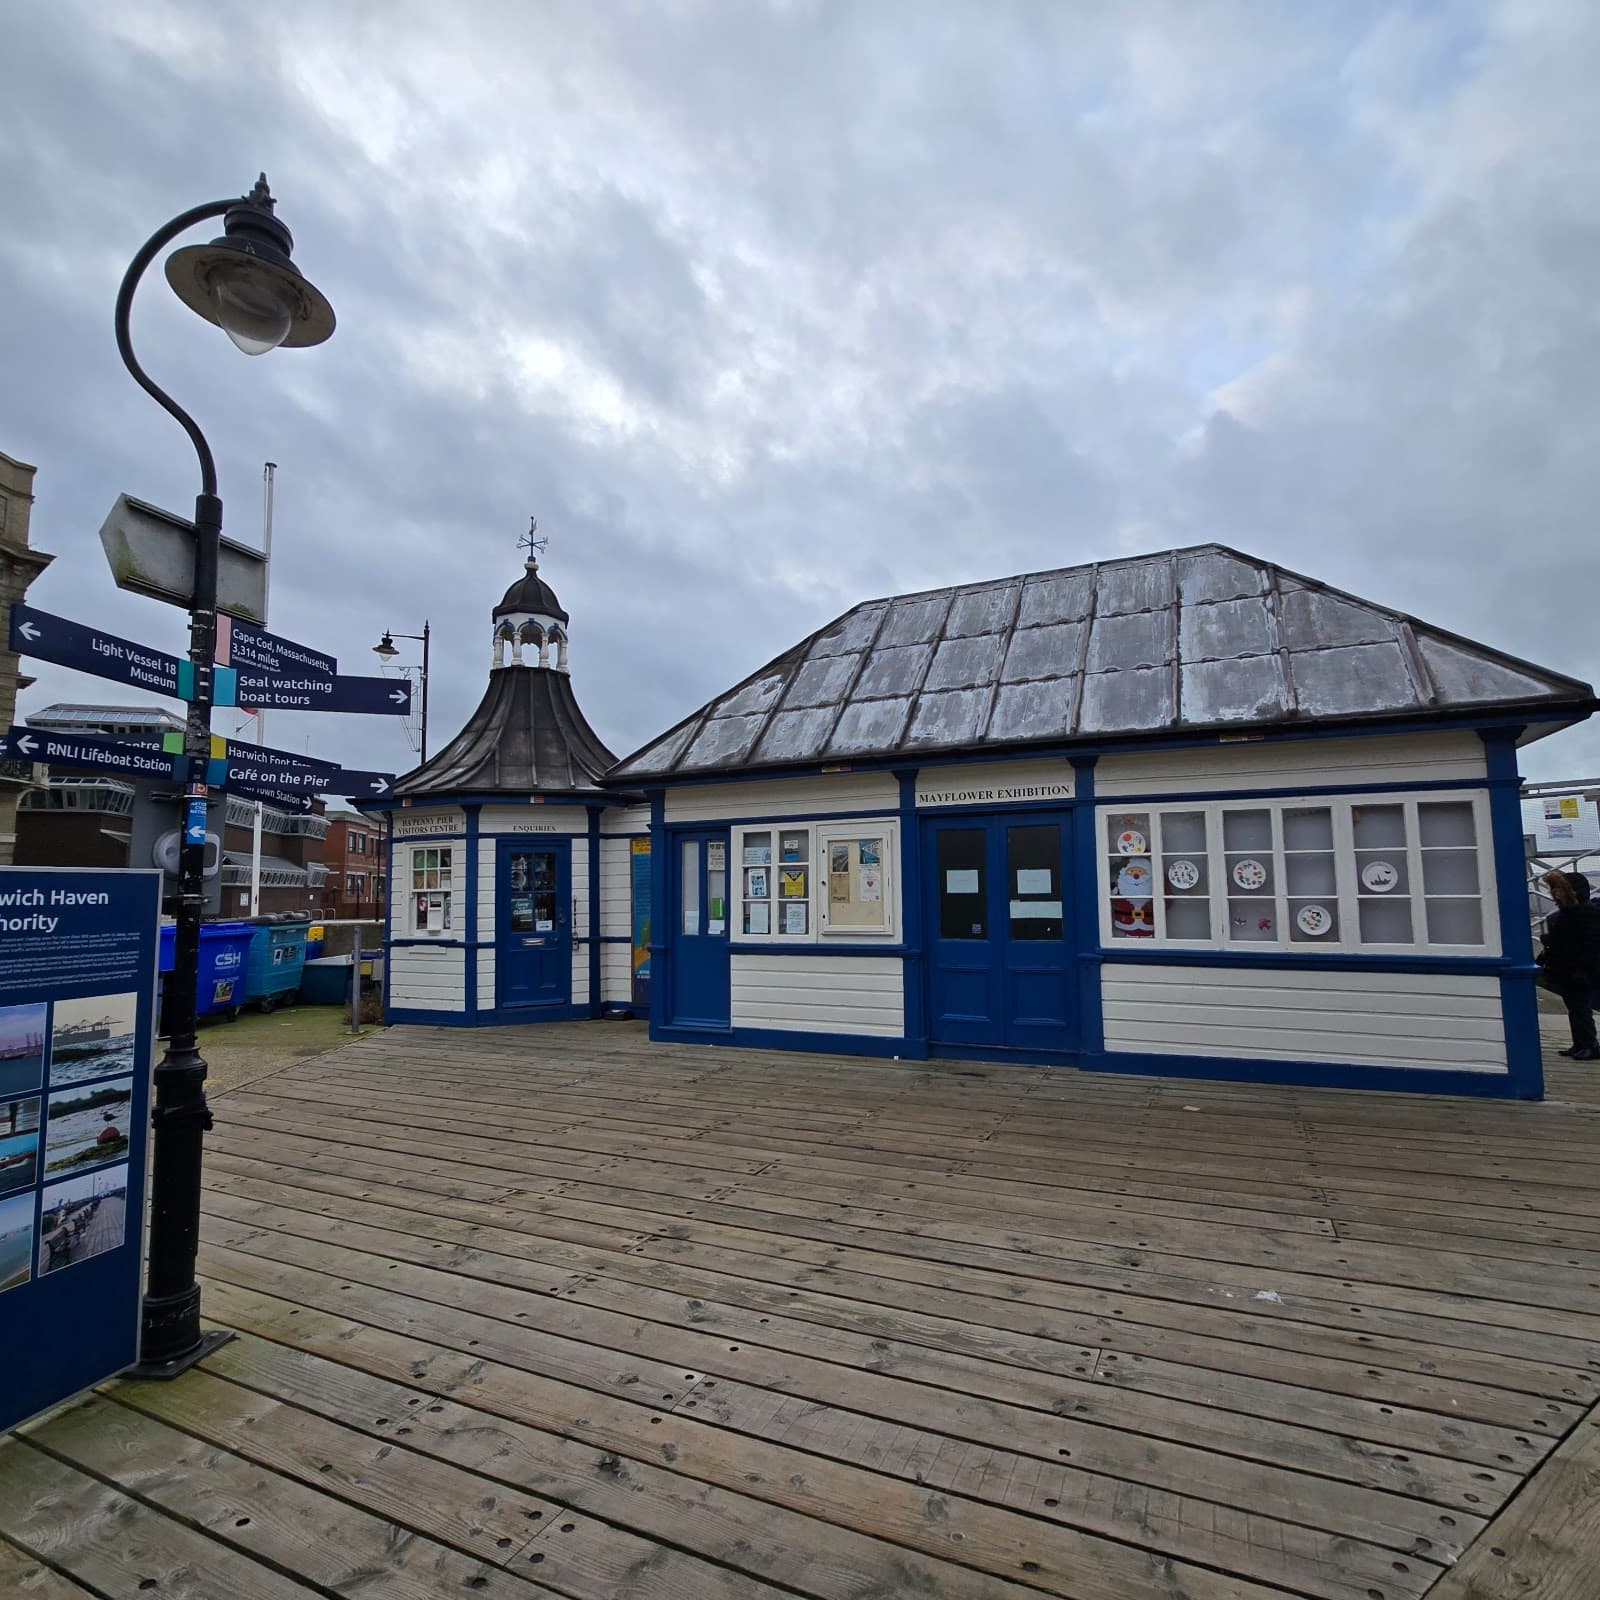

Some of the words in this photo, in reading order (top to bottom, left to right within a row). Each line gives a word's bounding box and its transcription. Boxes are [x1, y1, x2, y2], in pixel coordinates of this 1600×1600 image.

[92, 638, 123, 659] Light
[126, 649, 162, 671] Vessel
[164, 662, 177, 675] 18
[232, 643, 256, 659] 3,314
[258, 653, 280, 667] miles
[233, 629, 255, 644] Cape
[256, 637, 275, 653] Cod,
[276, 644, 329, 671] Massachusetts
[130, 667, 176, 690] Museum
[240, 676, 269, 688] Seal
[272, 679, 332, 693] watching
[240, 690, 271, 703] boat
[275, 693, 310, 705] tours
[47, 742, 77, 759] RNLI
[81, 748, 131, 767] Lifeboat
[133, 756, 172, 772] Station
[228, 746, 267, 763] Harwich
[229, 768, 258, 781] Café
[260, 773, 276, 783] on
[280, 772, 300, 785] the
[303, 774, 330, 787] Pier
[276, 790, 300, 805] Station
[919, 790, 993, 803] MAYFLOWER
[997, 785, 1070, 799] EXHIBITION
[437, 815, 454, 824] PIER
[399, 826, 428, 835] VISITORS
[429, 824, 459, 833] CENTRE
[51, 890, 109, 906] Haven
[215, 952, 241, 966] CSH
